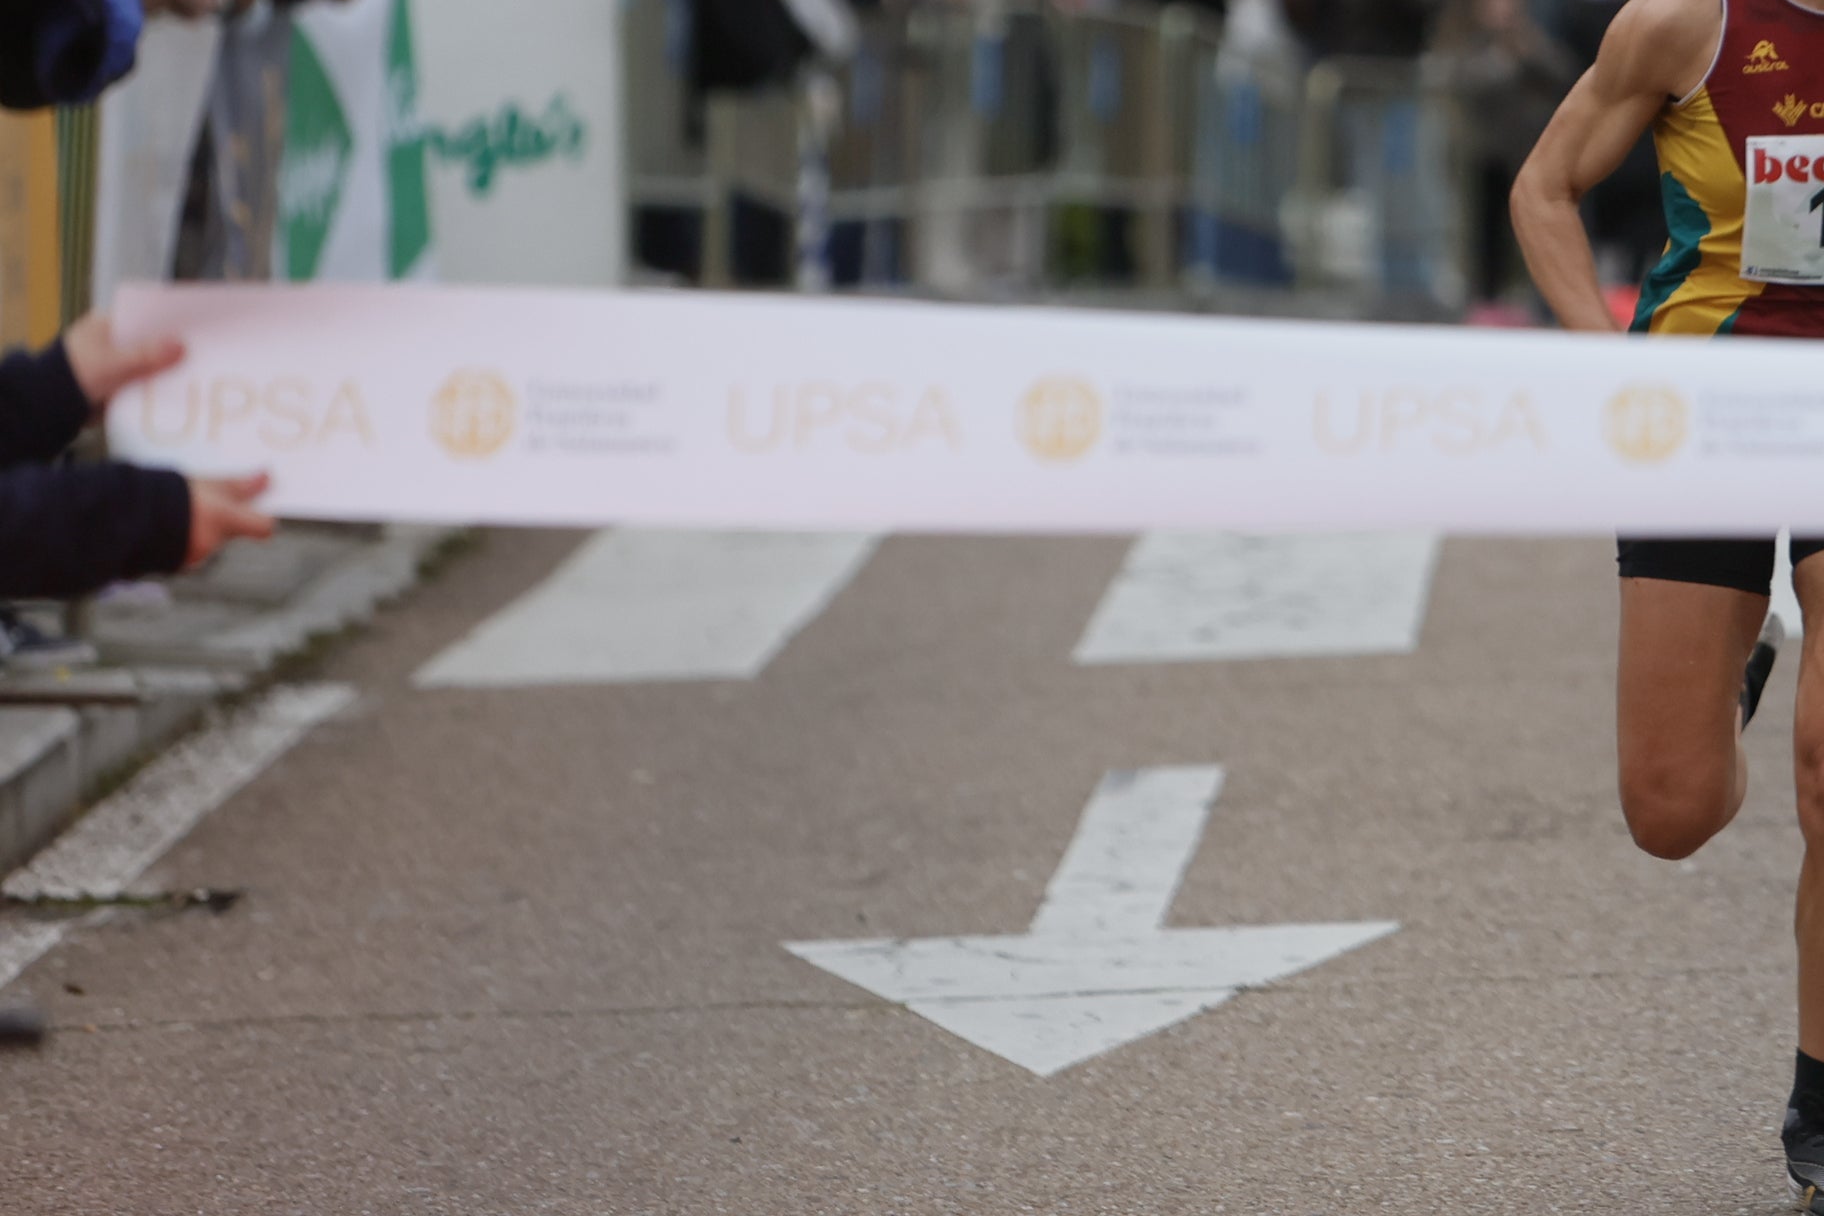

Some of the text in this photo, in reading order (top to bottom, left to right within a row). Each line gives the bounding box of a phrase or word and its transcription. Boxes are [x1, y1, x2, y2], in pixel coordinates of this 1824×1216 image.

[138, 376, 378, 454] UPSA
[725, 380, 963, 456] UPSA
[1312, 385, 1549, 457] UPSA
